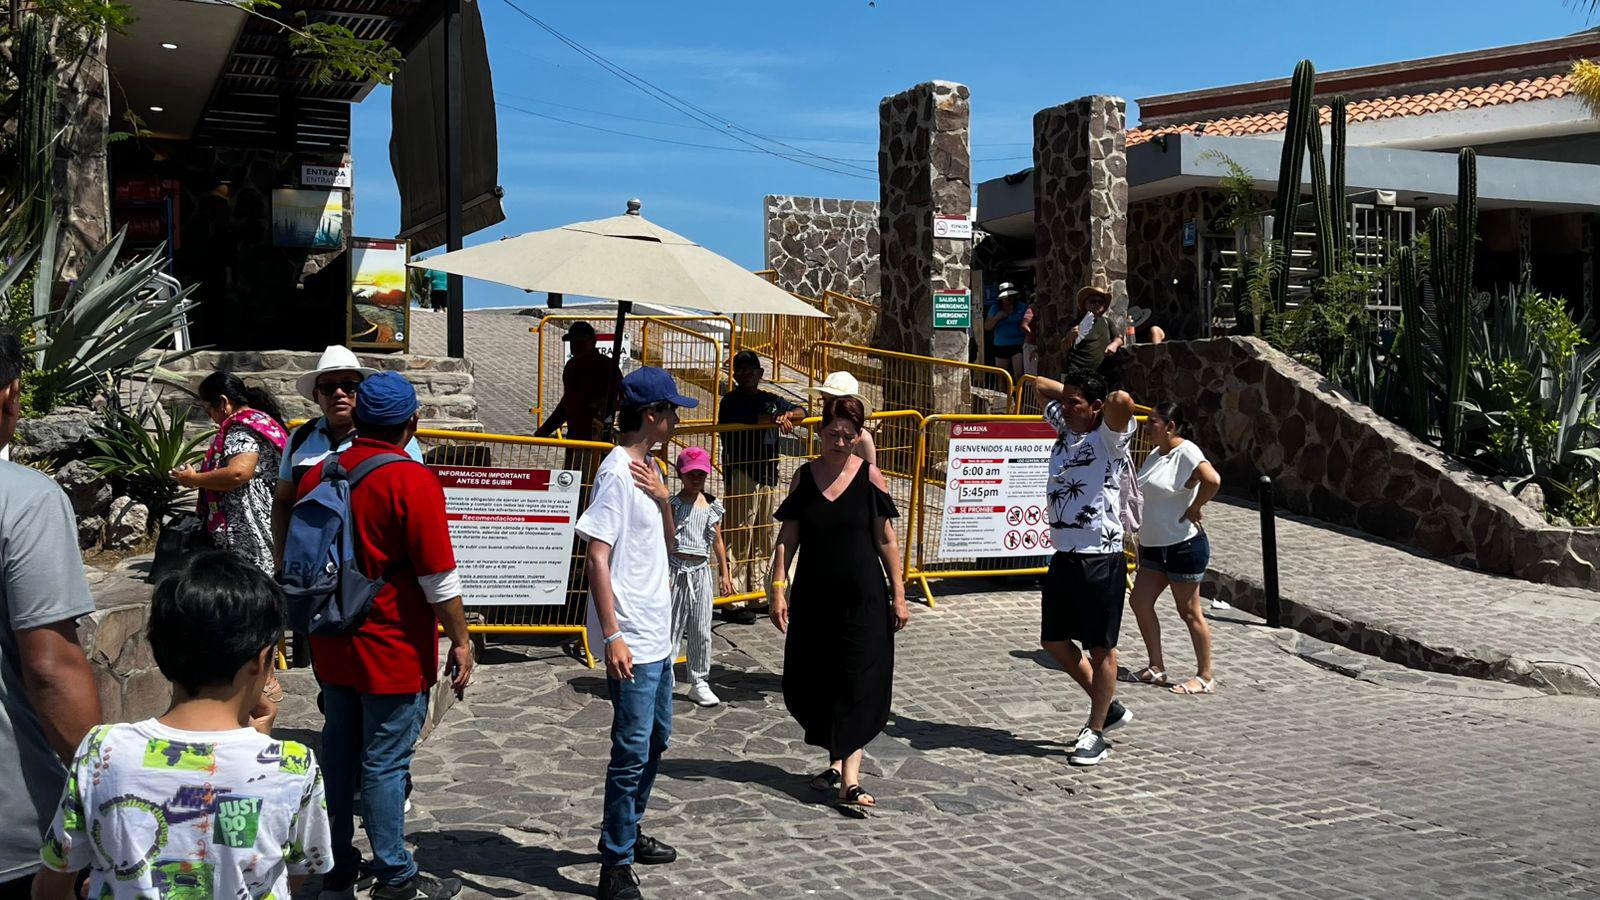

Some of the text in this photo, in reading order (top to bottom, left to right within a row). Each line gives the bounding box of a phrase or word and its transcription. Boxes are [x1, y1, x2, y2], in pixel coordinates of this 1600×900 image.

[306, 168, 346, 177] ENTRADA
[306, 176, 346, 185] ENTRANCE
[955, 445, 1003, 453] BIENVENIDOS
[1004, 445, 1013, 453] AL
[1014, 445, 1032, 453] FARO
[438, 470, 531, 480] INFORMACION IMPORTANTE
[962, 466, 1000, 476] 6:00 am
[962, 487, 999, 499] 5:45pm
[461, 514, 526, 522] Recomendaciones
[218, 797, 260, 818] JUST
[219, 814, 247, 832] DO
[223, 831, 243, 847] IT.
